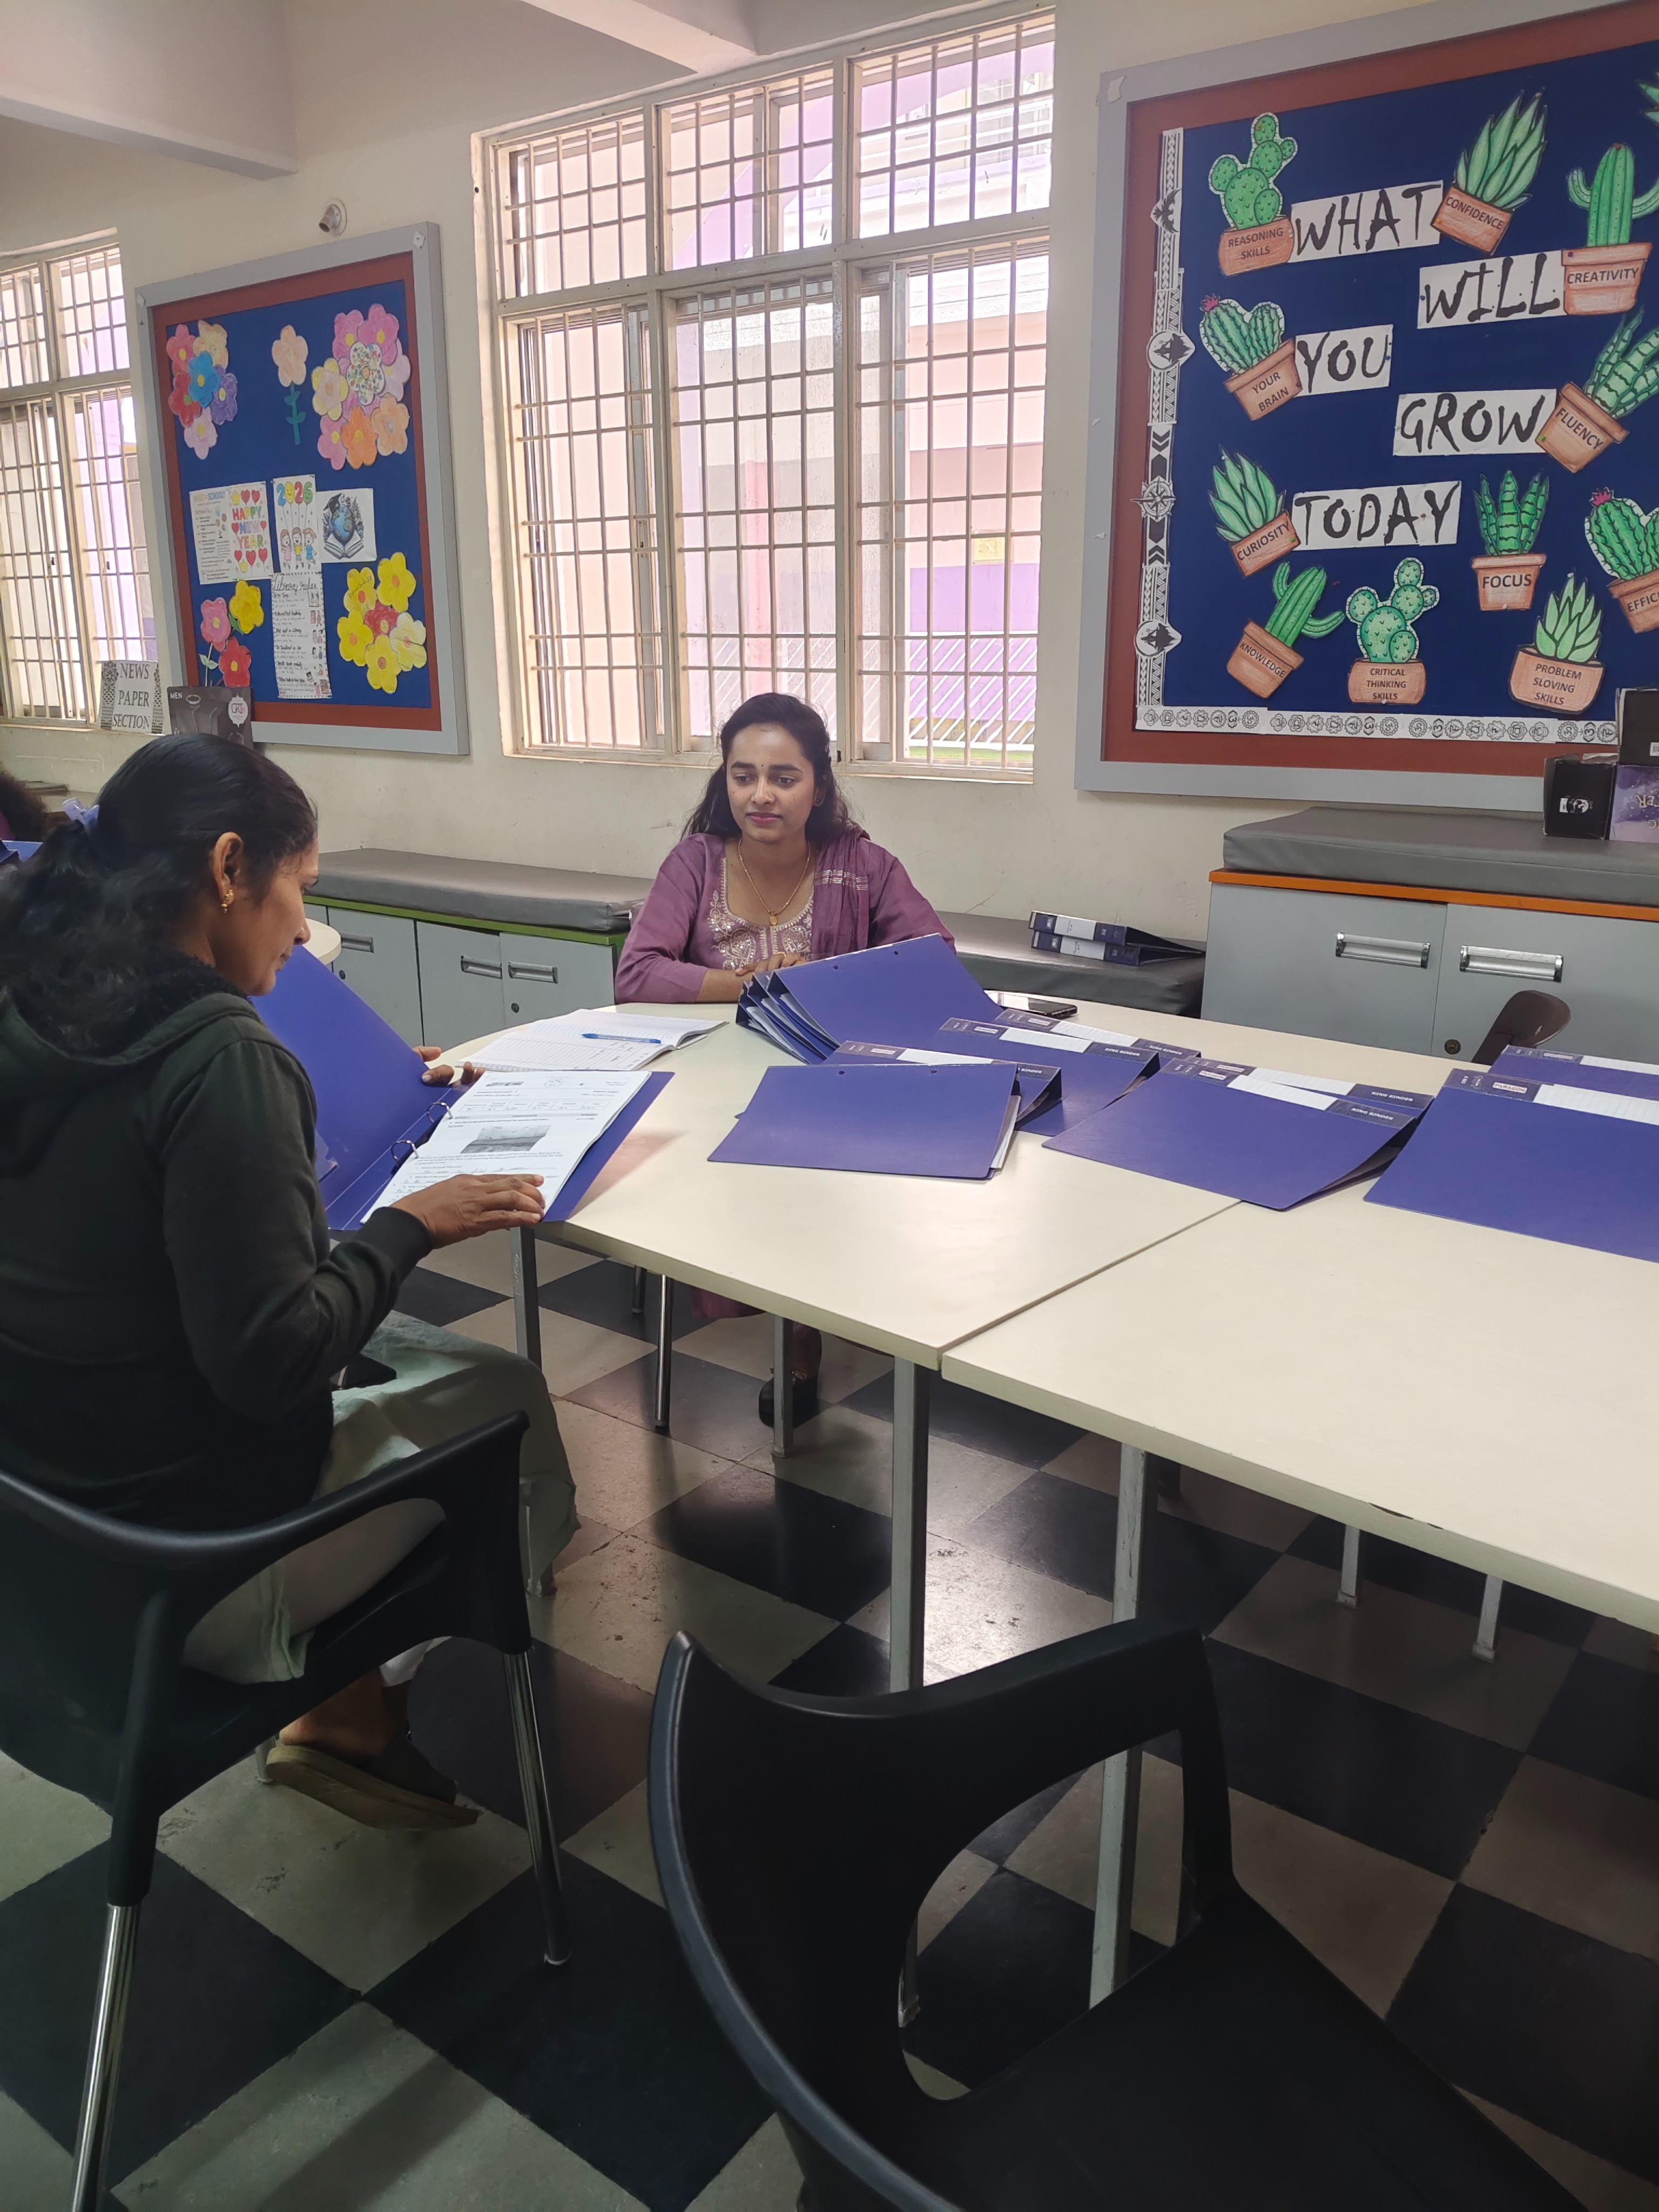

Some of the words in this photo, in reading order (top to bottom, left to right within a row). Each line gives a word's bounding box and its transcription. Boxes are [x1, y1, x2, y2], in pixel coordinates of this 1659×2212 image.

[1295, 185, 1441, 255] WHAT
[1446, 195, 1505, 231] CONFIDENCE
[1228, 227, 1284, 248] REASONING
[1240, 244, 1271, 260] SKILLS
[1567, 267, 1640, 285] CREATIVITY
[1425, 253, 1561, 322] WILL
[1298, 333, 1388, 393] YOU
[1251, 371, 1282, 394] YOUR
[1258, 388, 1289, 412] BRAIN
[1401, 393, 1543, 453] GROW
[1555, 408, 1605, 450] FLUENCY
[276, 481, 313, 506] 2026
[232, 505, 262, 521] HAPPY
[1295, 484, 1459, 546] TODAY
[239, 520, 261, 535] NEW
[237, 535, 264, 549] YEAR
[1237, 522, 1291, 562] CURIOSITY
[1482, 572, 1532, 589] FOCUS
[1239, 642, 1286, 679] KNOWLEDGE
[119, 663, 150, 679] NEWS
[1370, 667, 1406, 677] CRITICAL
[1535, 663, 1582, 681] PROBLEM
[1366, 680, 1407, 689] THINKING
[1533, 677, 1575, 694] SLOVING
[118, 690, 150, 707] PAPER
[1372, 692, 1398, 700] SKILLS
[1534, 691, 1565, 707] SKILLS
[112, 714, 150, 729] SECTION
[1493, 1083, 1527, 1092] PARAGON
[1388, 1094, 1414, 1102] BINDER
[1368, 1111, 1394, 1121] BINDER
